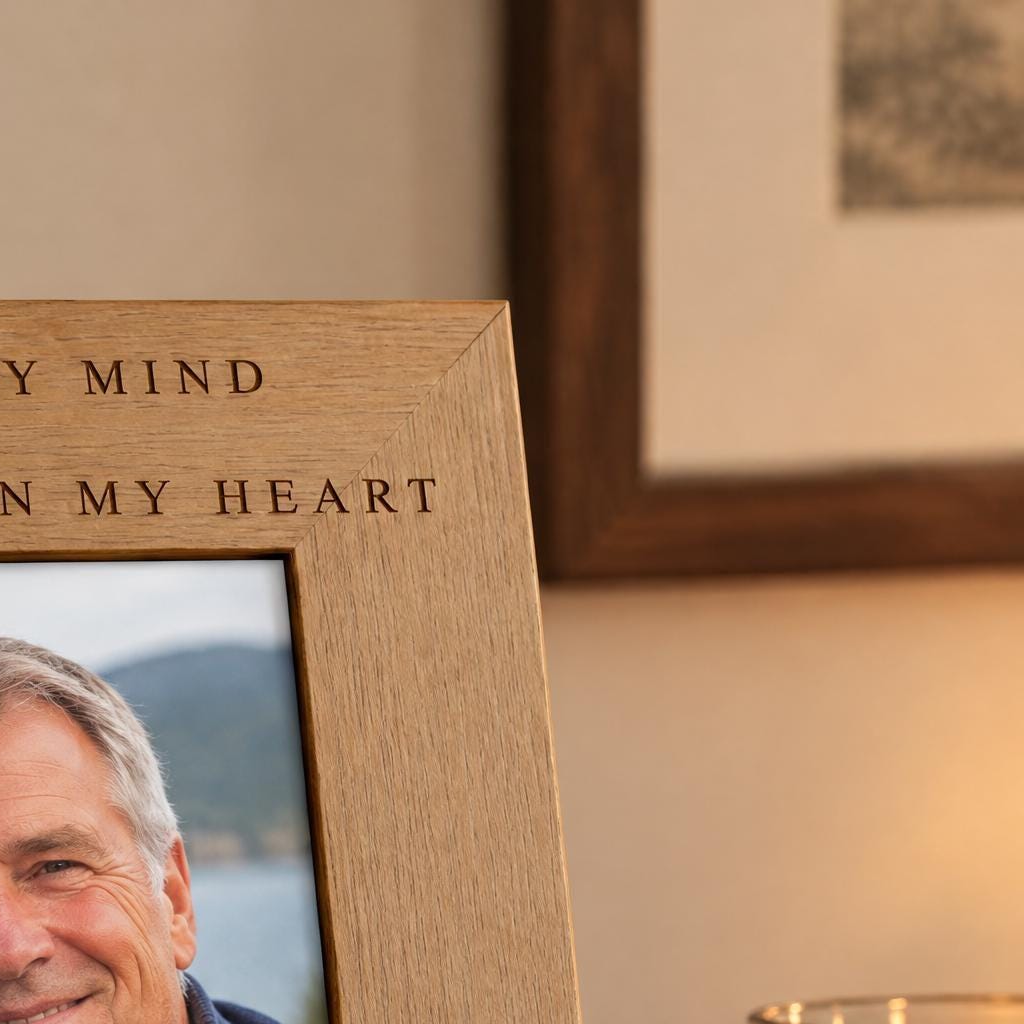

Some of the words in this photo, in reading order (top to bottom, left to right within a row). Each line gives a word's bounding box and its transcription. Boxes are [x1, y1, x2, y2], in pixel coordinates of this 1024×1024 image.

[81, 359, 264, 395] MIND
[76, 479, 170, 515] MY
[213, 477, 436, 514] HEART
